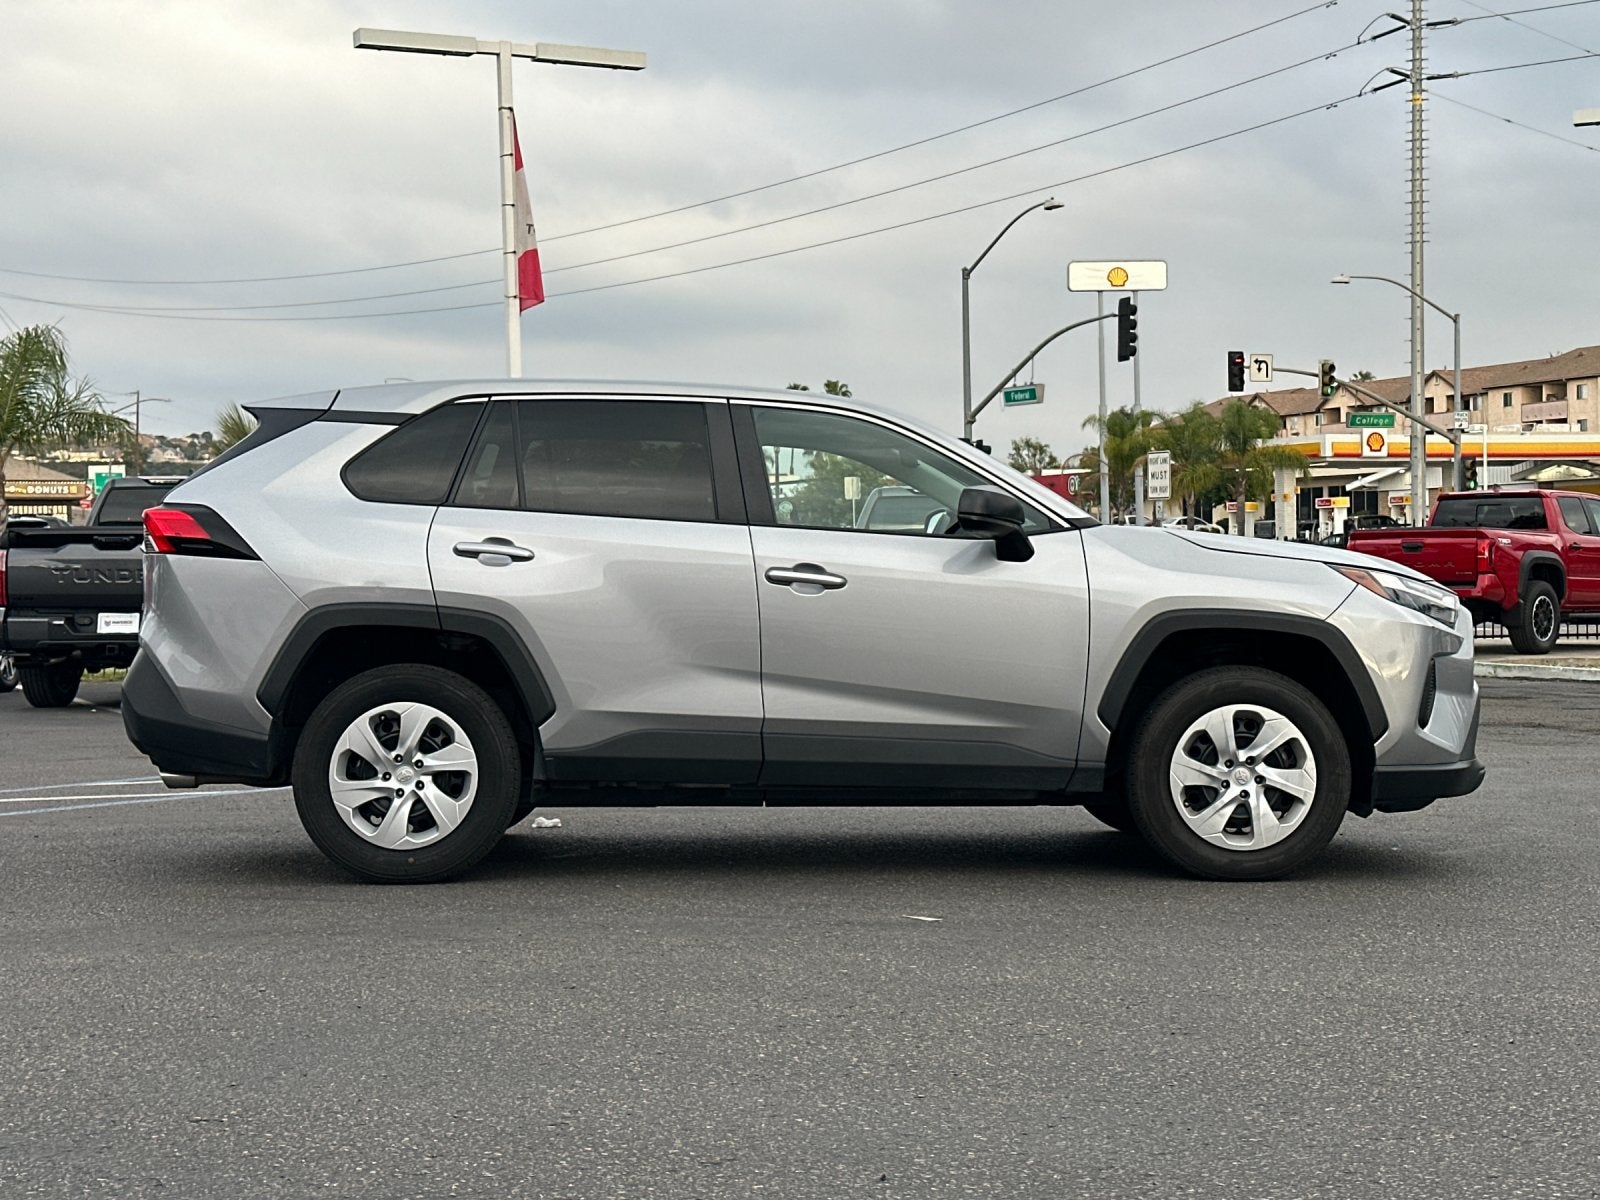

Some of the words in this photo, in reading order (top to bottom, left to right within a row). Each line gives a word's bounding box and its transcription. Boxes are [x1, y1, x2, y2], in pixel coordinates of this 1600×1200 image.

[1010, 391, 1030, 401] Federal
[1355, 416, 1389, 426] College
[1149, 457, 1159, 465] RIGHT
[1160, 456, 1168, 465] LANE
[1150, 470, 1168, 480] MUST
[27, 485, 69, 494] DONUTS
[1150, 485, 1158, 494] TURN
[1159, 485, 1168, 494] RIGHT
